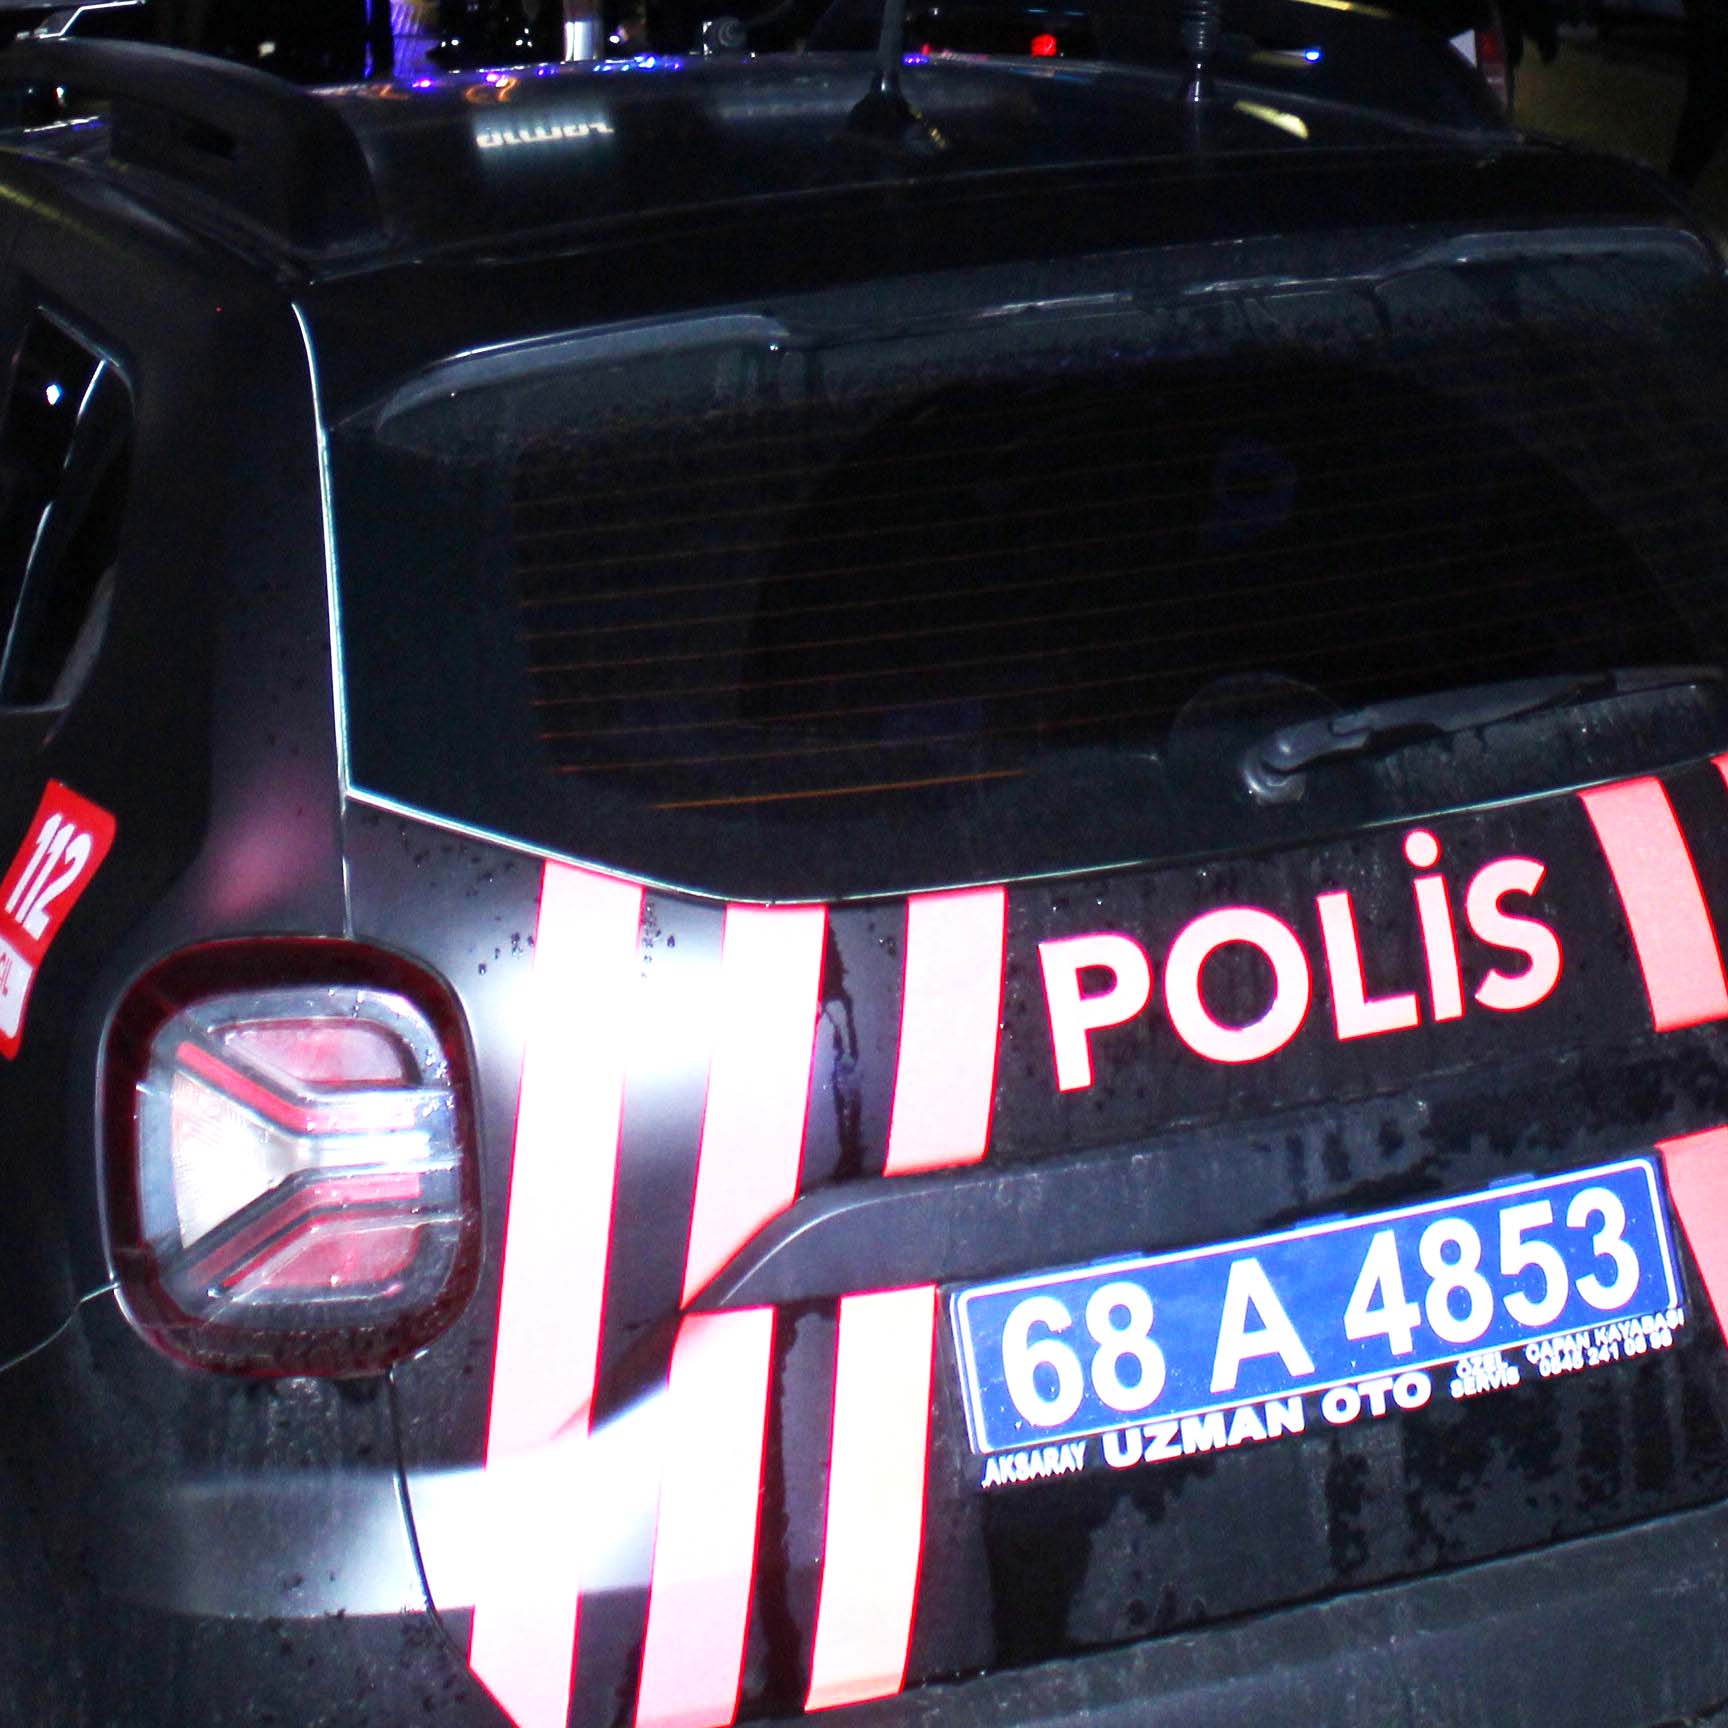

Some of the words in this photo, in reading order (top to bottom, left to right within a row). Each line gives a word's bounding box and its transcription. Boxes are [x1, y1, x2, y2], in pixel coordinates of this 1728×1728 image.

[4, 812, 93, 942] 112
[1037, 830, 1564, 1093] POLİS
[1001, 1279, 1167, 1428] 68
[1210, 1257, 1314, 1395] A
[1343, 1187, 1642, 1357] 4853
[1455, 1350, 1510, 1379] ÖZEL
[980, 1439, 1088, 1489] AKSARAY
[1101, 1395, 1306, 1470] UZMAN
[1321, 1371, 1432, 1424] OTO
